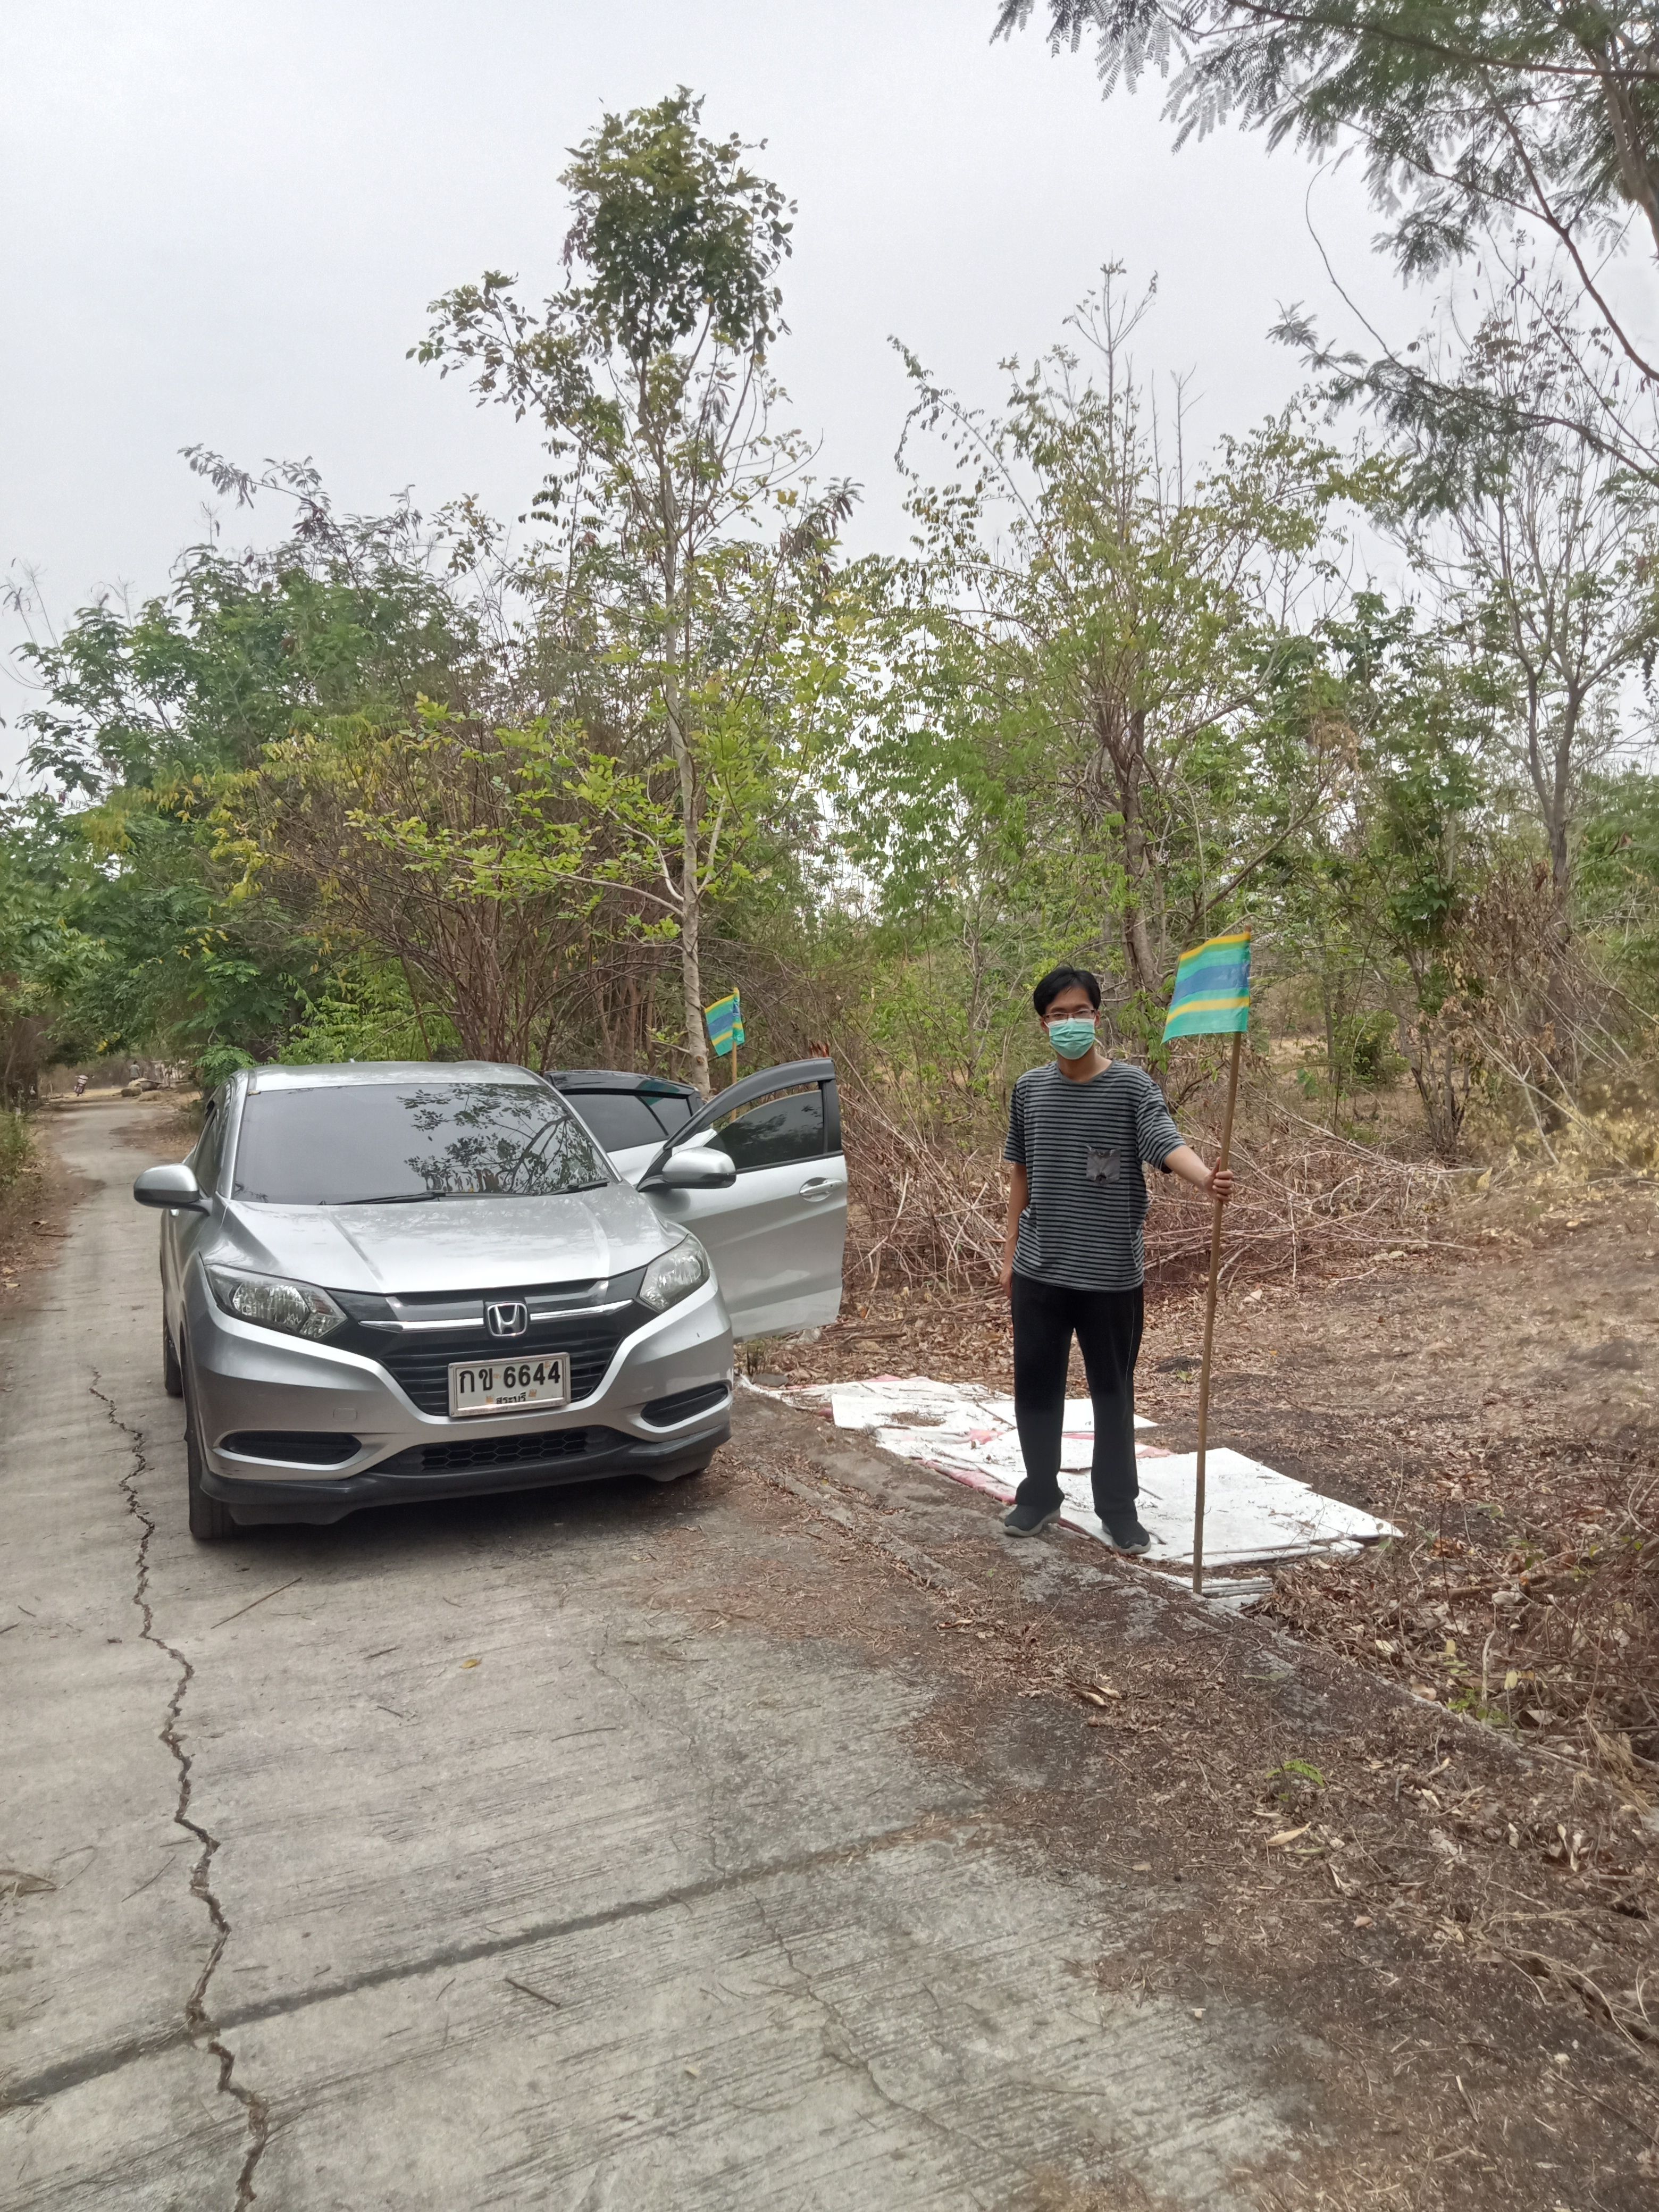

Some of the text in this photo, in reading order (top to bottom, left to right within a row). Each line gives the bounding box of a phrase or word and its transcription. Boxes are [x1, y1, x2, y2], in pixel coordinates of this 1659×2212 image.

[459, 1361, 560, 1393] กข 6644
[496, 1392, 526, 1404] สระบรี
